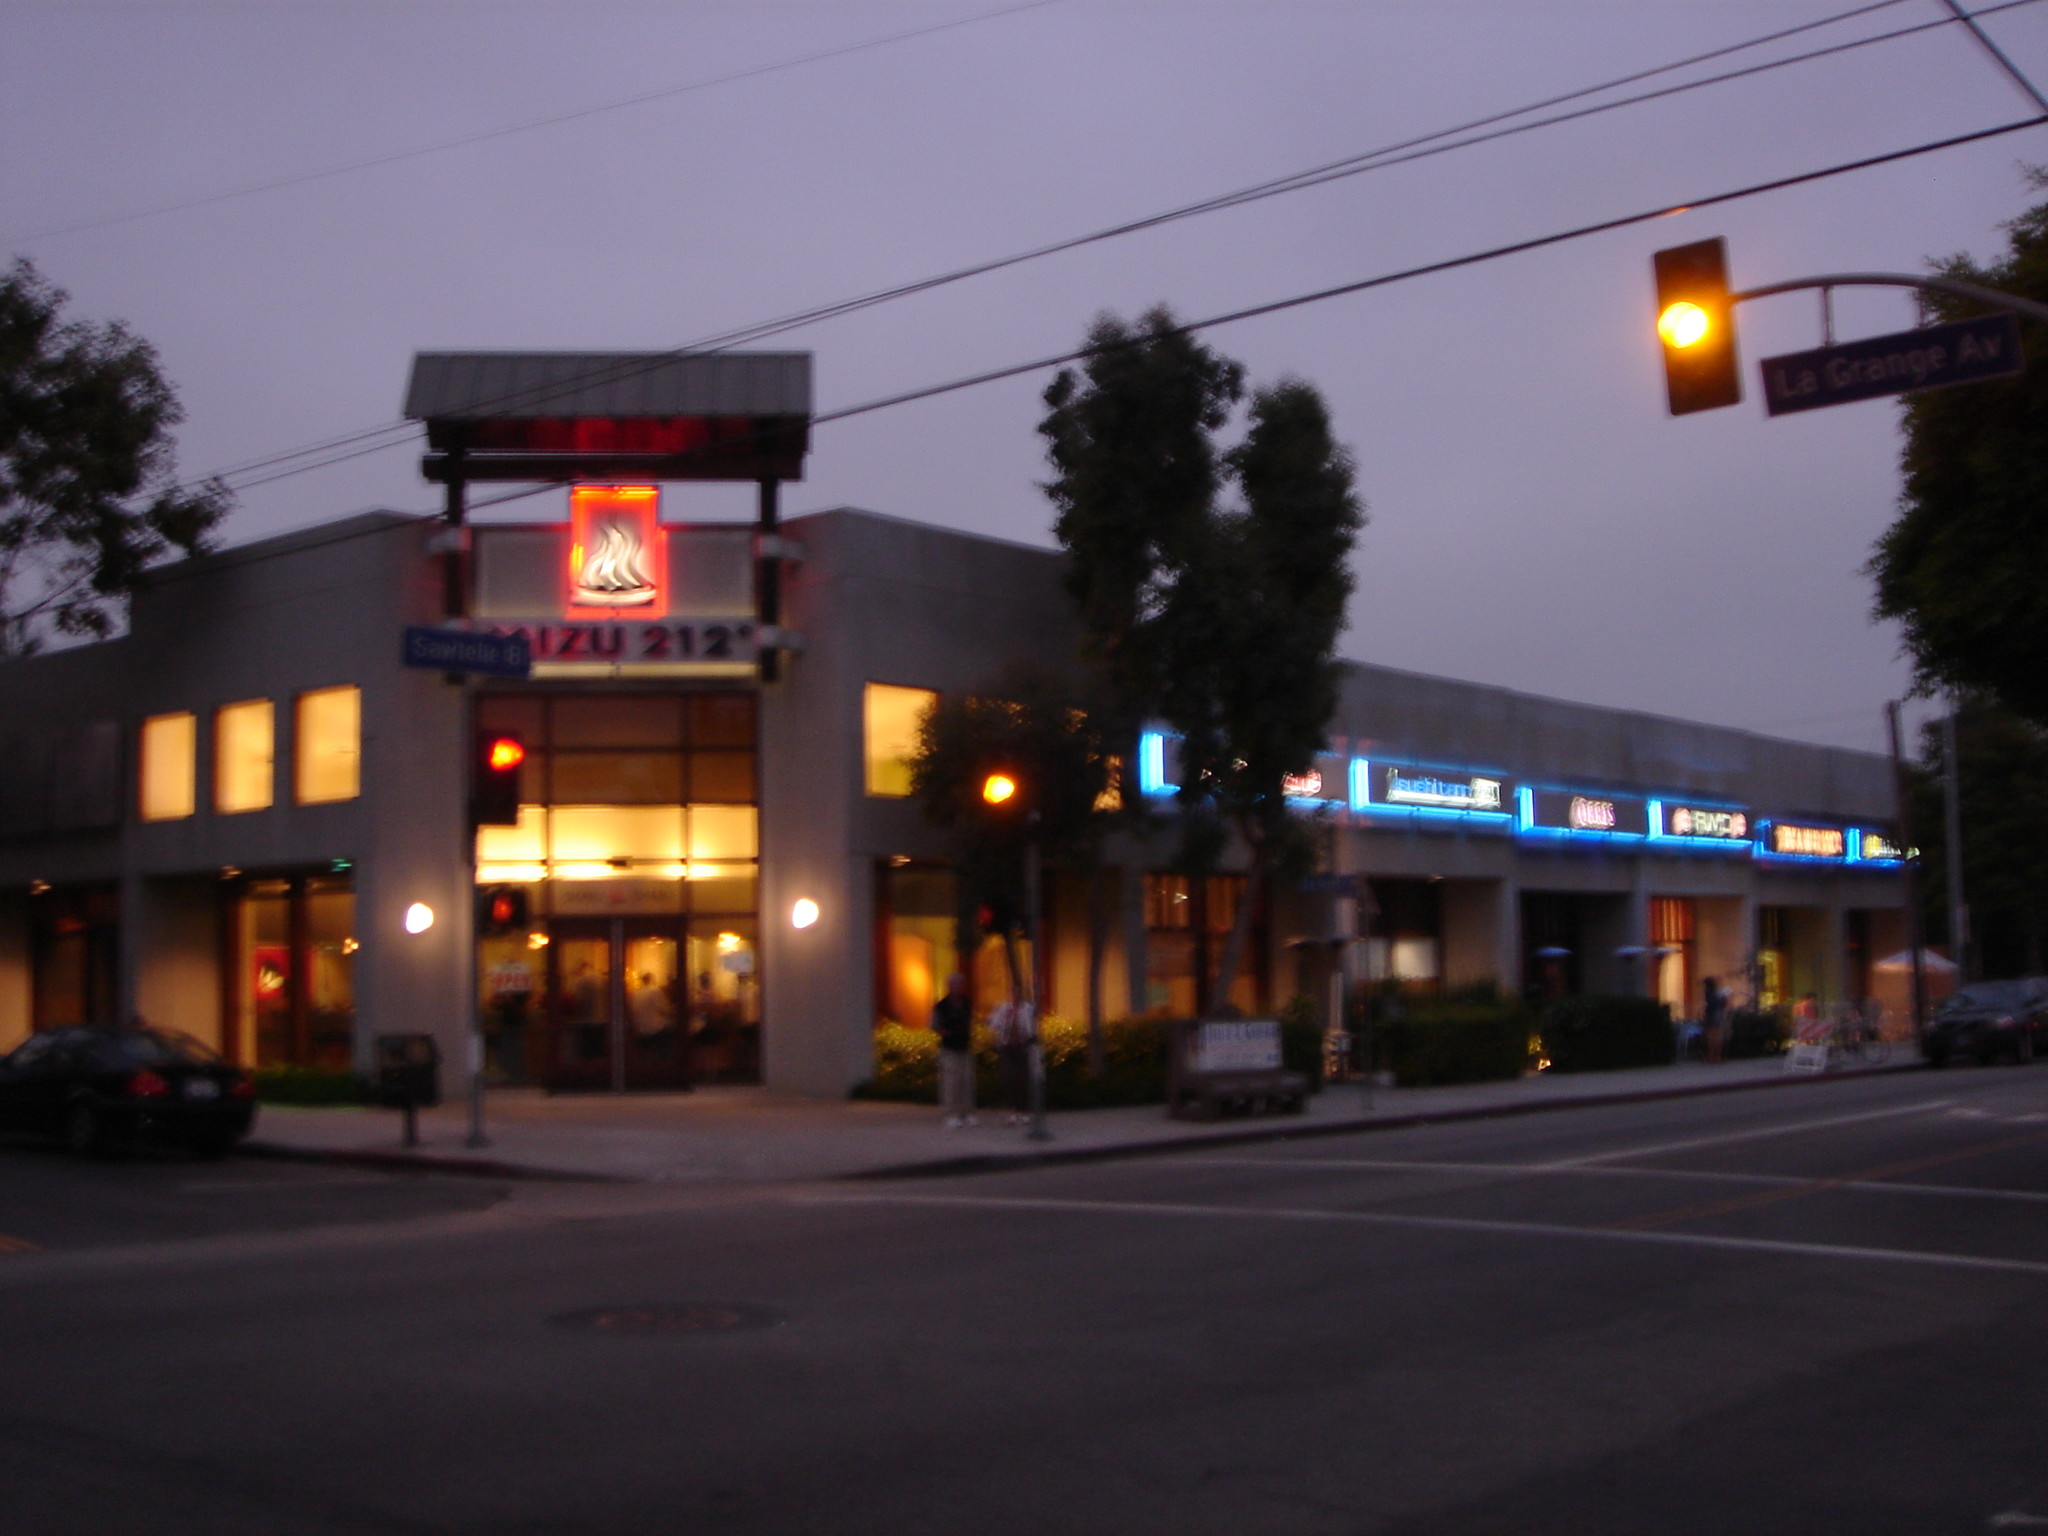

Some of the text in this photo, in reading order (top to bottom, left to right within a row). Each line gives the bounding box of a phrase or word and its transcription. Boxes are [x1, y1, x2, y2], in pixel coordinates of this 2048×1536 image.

[1773, 332, 2003, 399] La Grange Av
[493, 625, 626, 656] IZU
